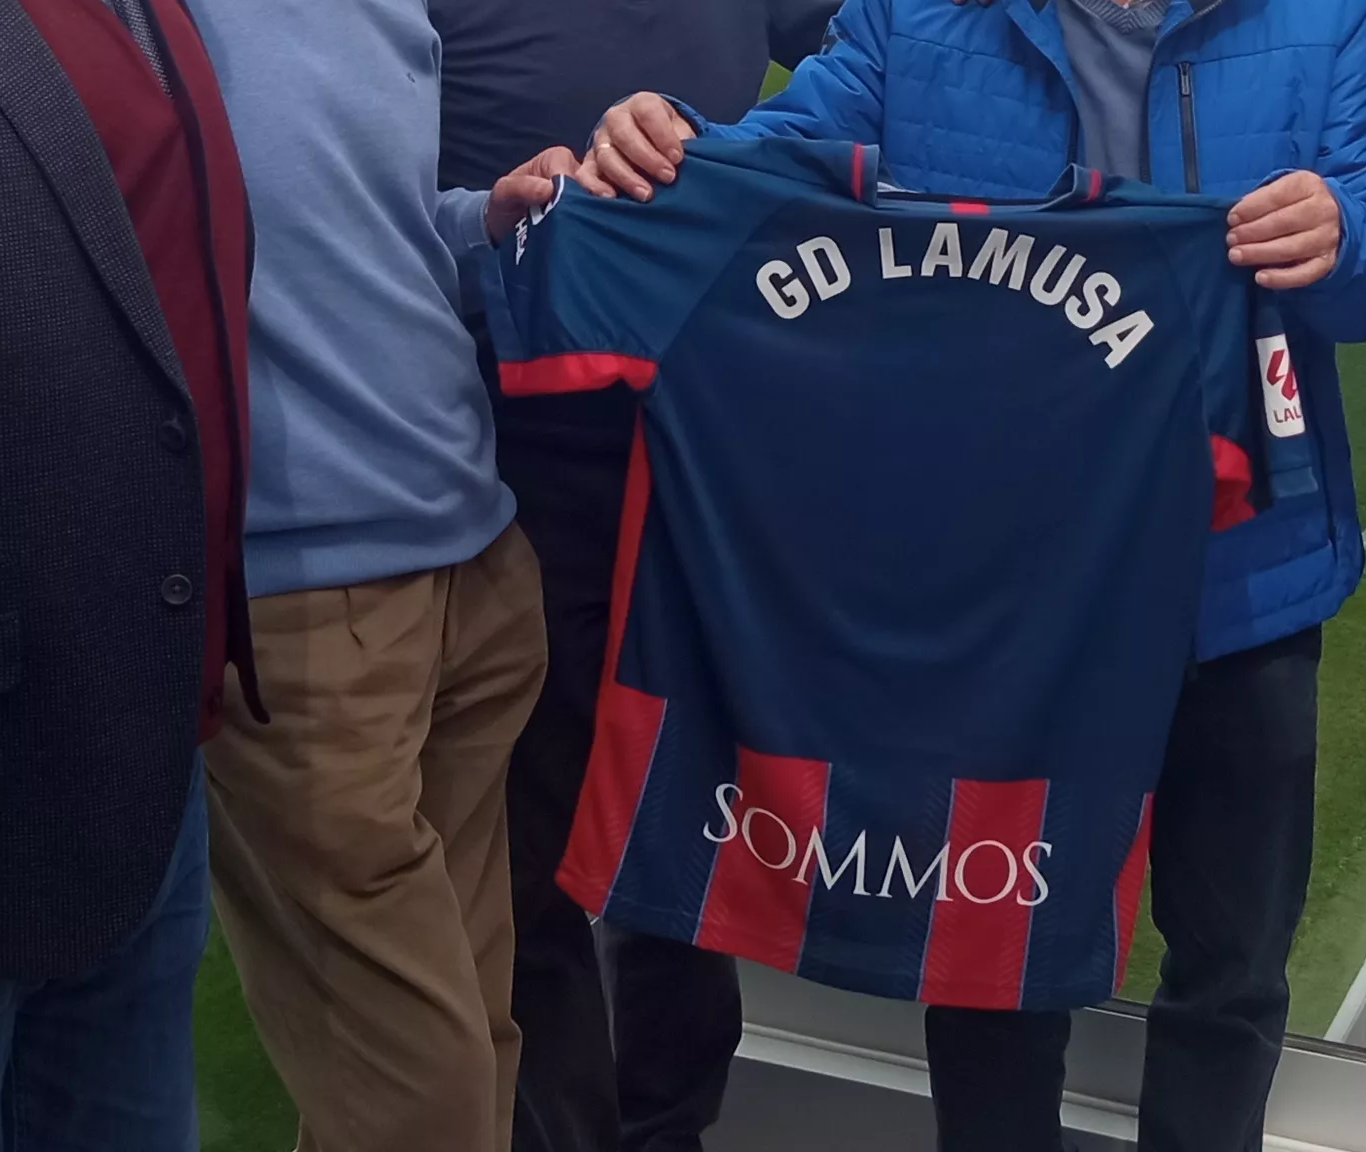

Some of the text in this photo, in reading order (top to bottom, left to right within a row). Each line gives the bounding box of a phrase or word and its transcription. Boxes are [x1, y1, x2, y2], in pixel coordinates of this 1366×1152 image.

[755, 222, 1155, 370] GD LAMUSA
[702, 782, 1053, 907] SOMMOS
